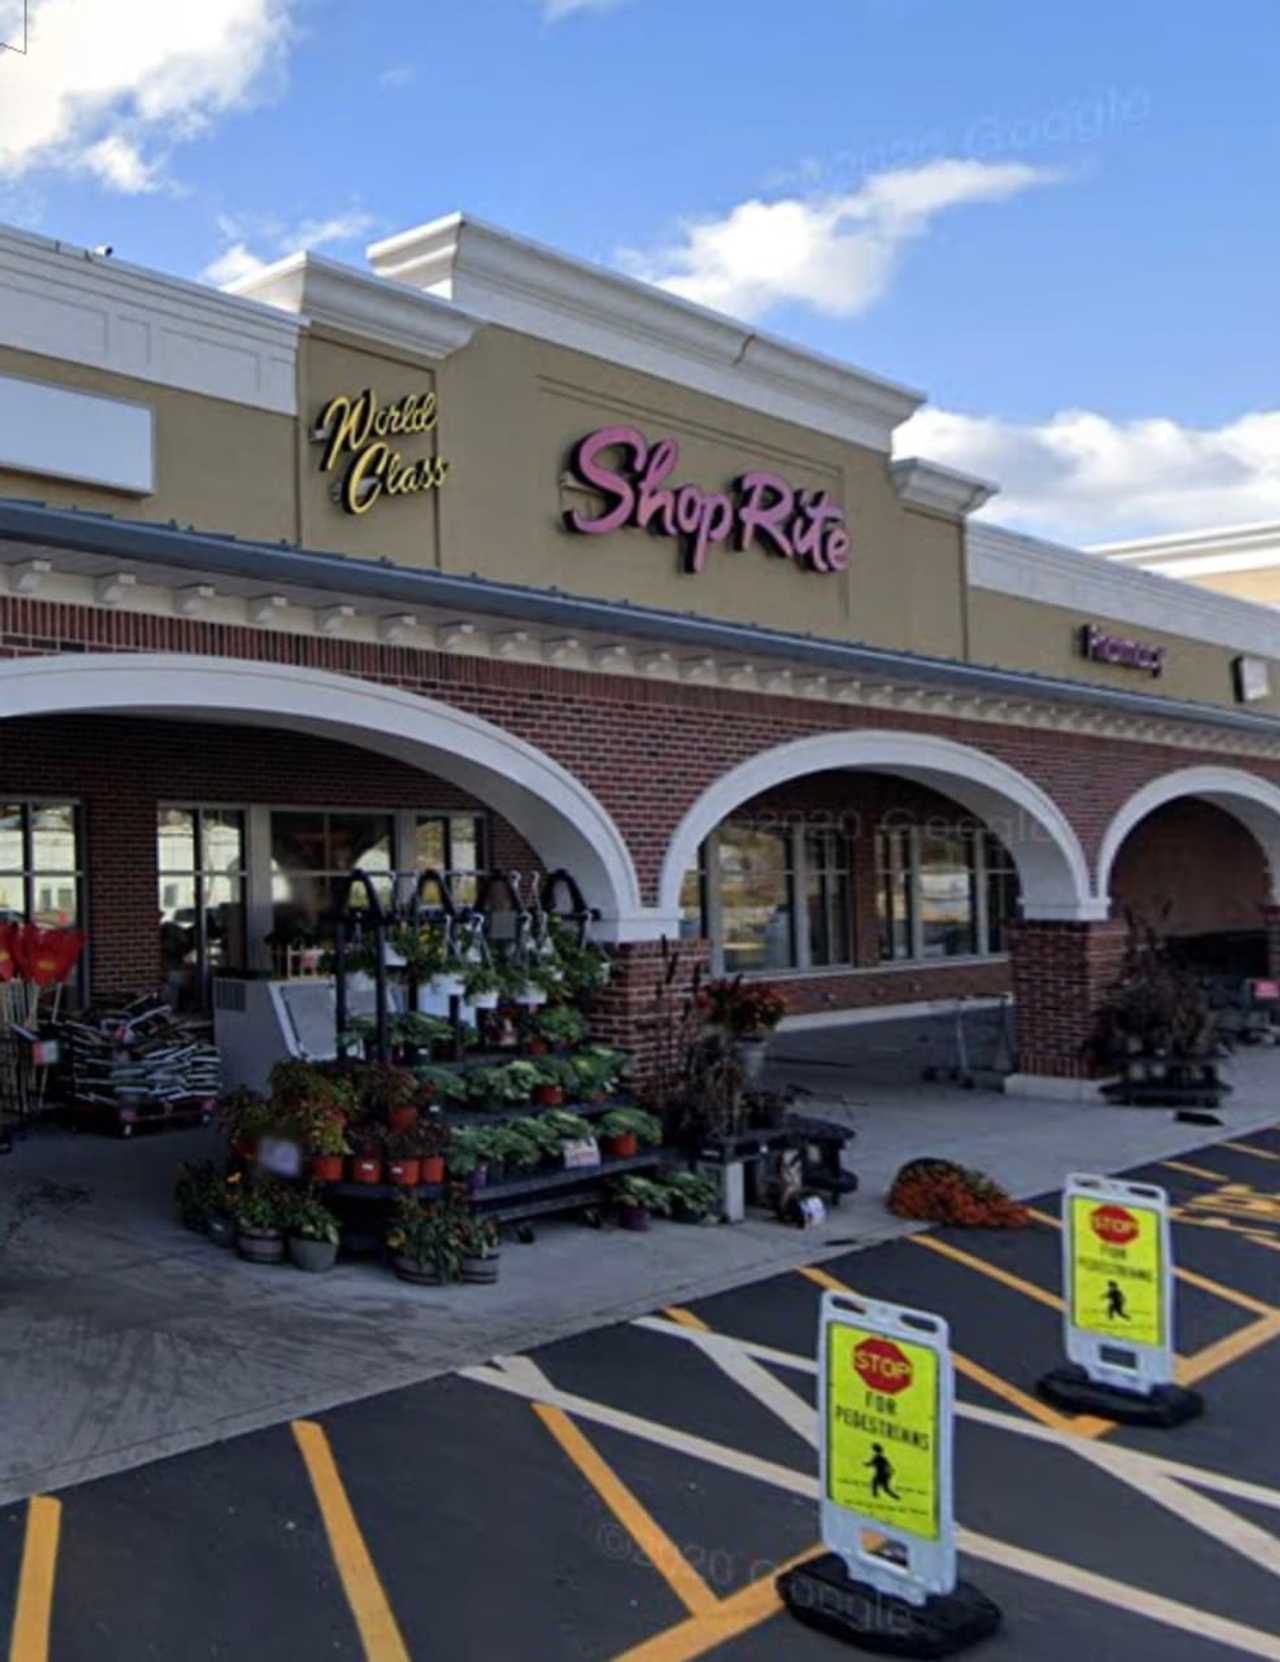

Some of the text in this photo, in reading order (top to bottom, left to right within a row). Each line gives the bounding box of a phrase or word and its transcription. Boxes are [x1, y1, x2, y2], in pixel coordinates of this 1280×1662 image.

[318, 388, 438, 471] World
[347, 441, 449, 515] Class
[854, 1349, 912, 1378] STOP
[864, 1390, 897, 1415] FOR
[835, 1404, 930, 1451] PEDESTRIANS
